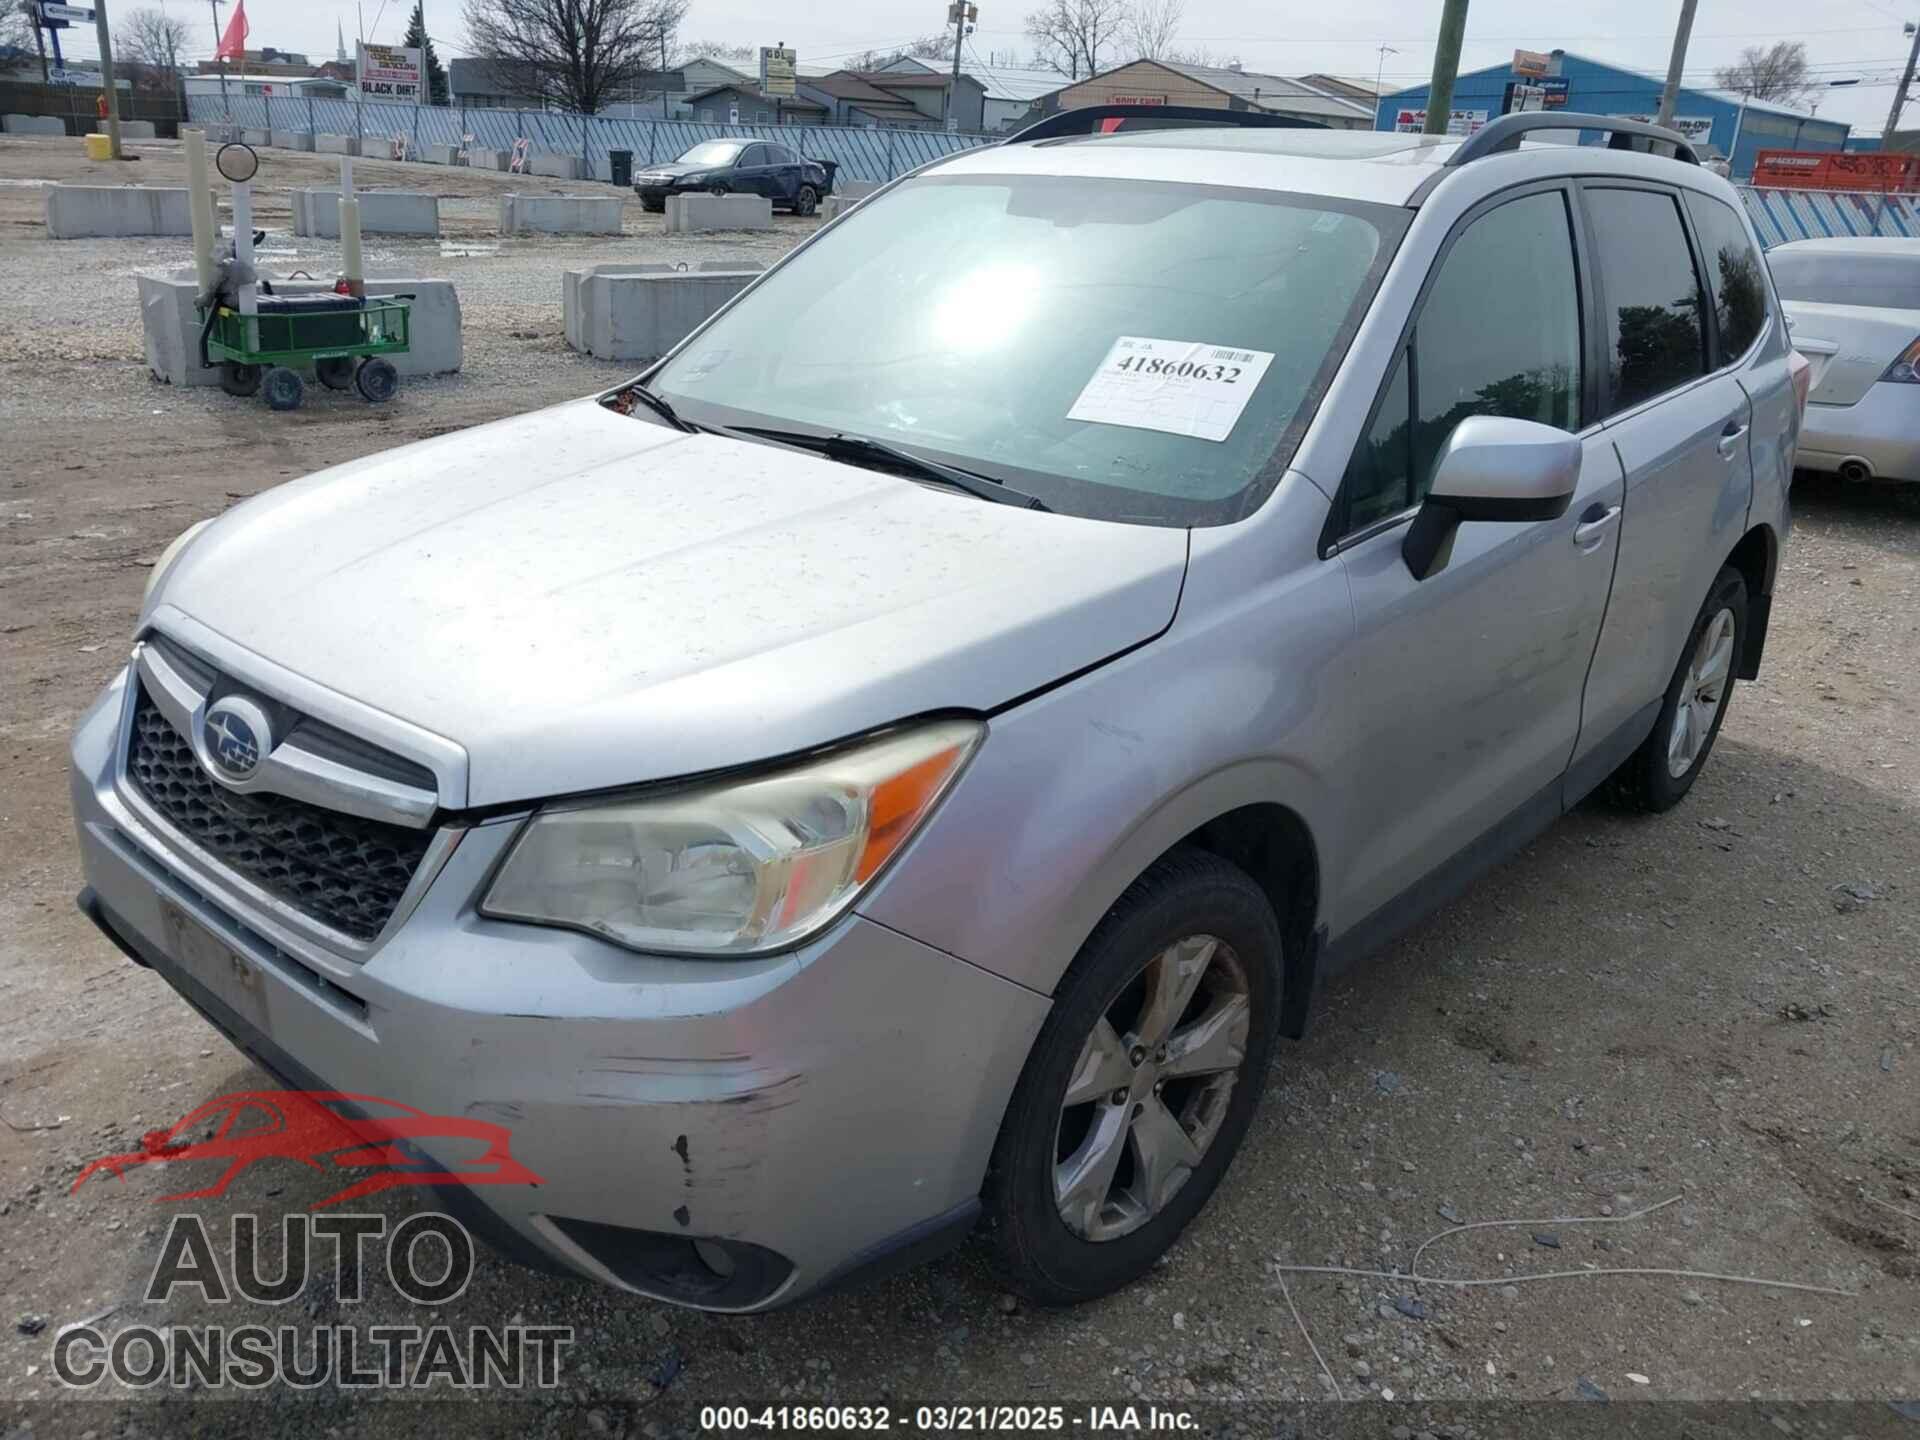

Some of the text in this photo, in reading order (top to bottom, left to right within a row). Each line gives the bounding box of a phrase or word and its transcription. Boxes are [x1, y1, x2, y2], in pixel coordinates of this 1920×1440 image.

[362, 82, 416, 96] BLACK DIRT
[1117, 355, 1242, 384] 41860632
